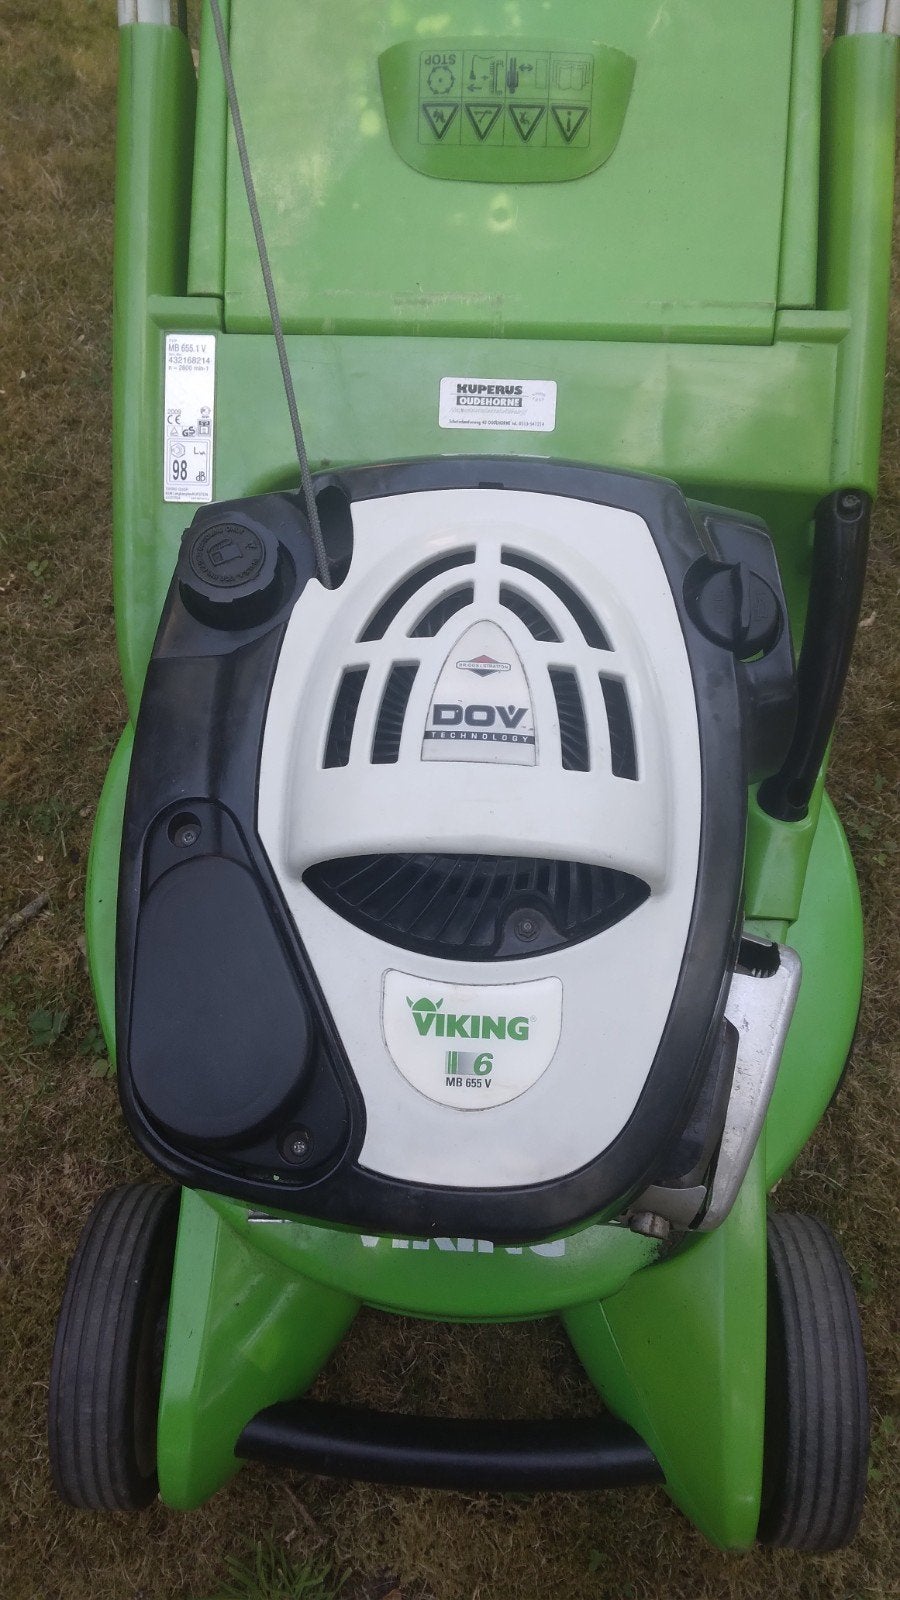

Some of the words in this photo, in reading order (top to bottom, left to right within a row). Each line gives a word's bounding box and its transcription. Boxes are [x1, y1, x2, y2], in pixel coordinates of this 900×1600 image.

[425, 53, 457, 65] STOP
[168, 343, 179, 352] MB
[201, 344, 207, 353] V
[168, 356, 210, 365] 432168214
[457, 383, 523, 395] KUPERUS
[459, 396, 520, 407] OUDEHORNE
[182, 426, 196, 437] GS
[172, 459, 188, 481] 98
[195, 471, 206, 482] dB
[432, 703, 529, 729] DOV
[431, 731, 529, 742] TECHNOLOGY
[411, 1011, 530, 1041] VIKING
[473, 1052, 495, 1076] 6
[445, 1077, 463, 1087] MB
[465, 1078, 482, 1088] 655
[485, 1078, 492, 1089] V
